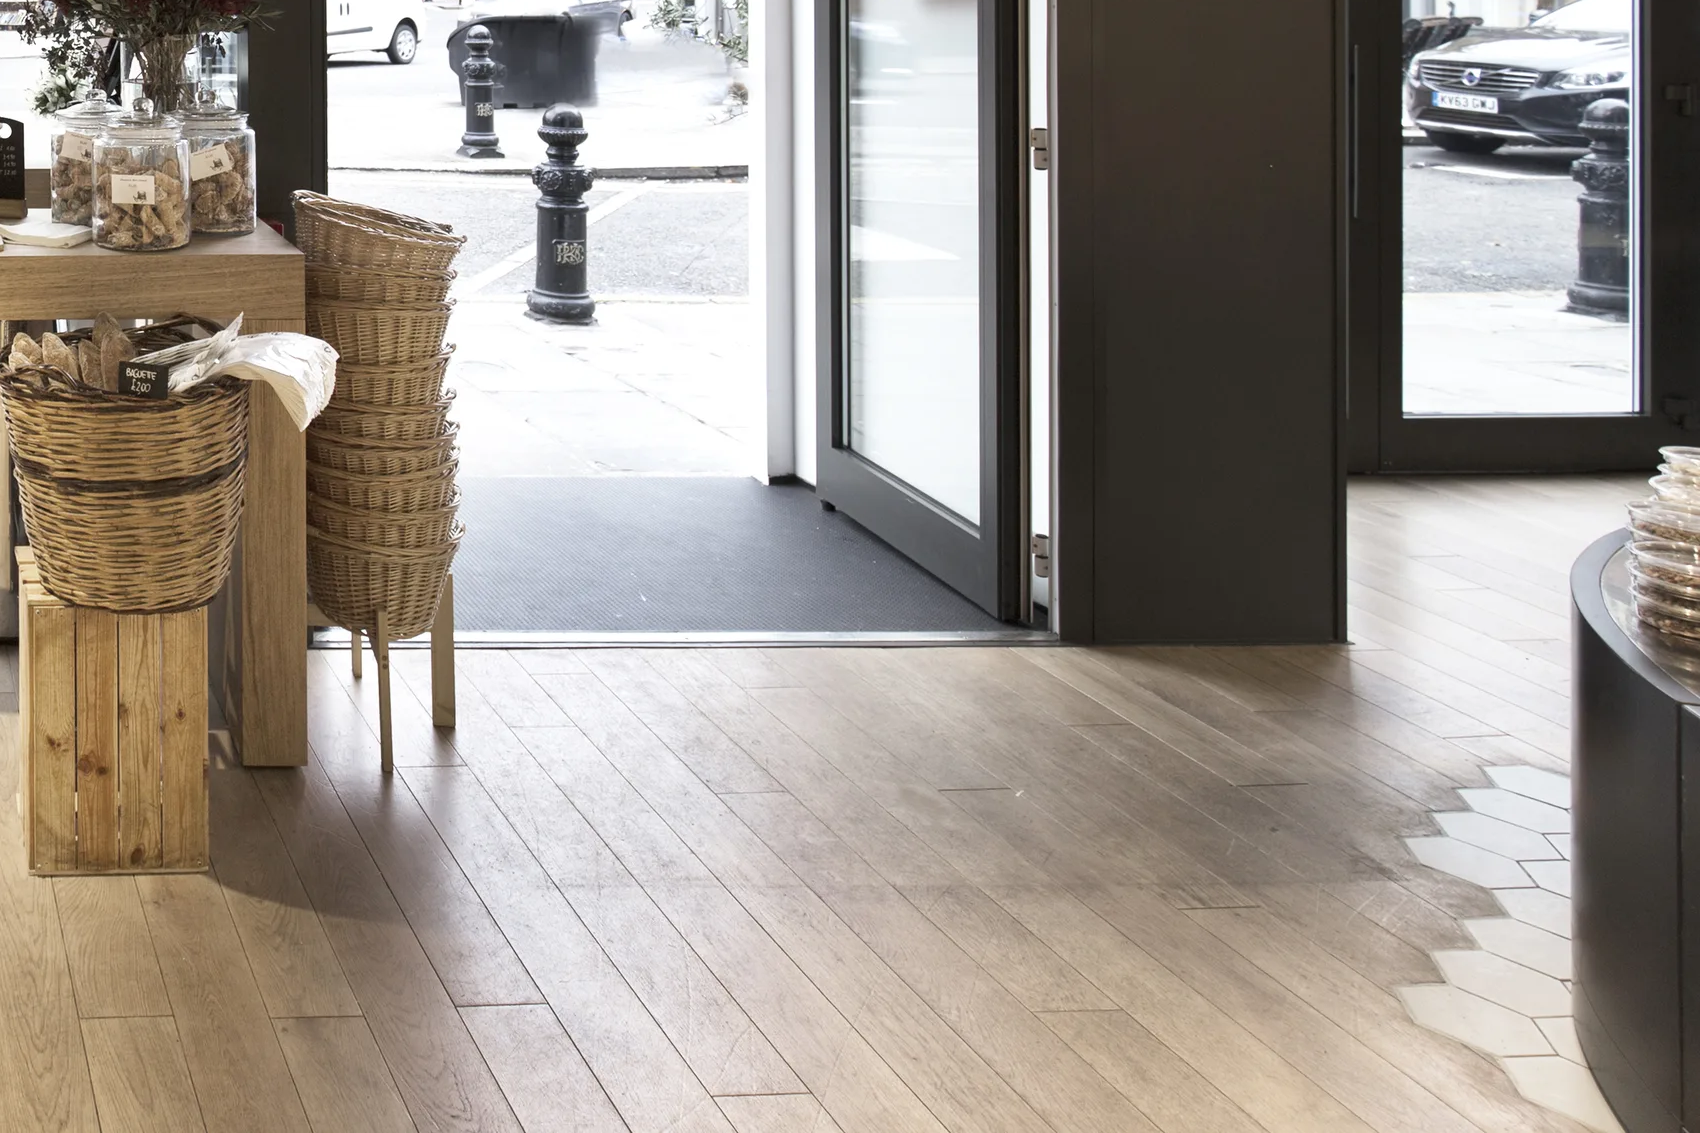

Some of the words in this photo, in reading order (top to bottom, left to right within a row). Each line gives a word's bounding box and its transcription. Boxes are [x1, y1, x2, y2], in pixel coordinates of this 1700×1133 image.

[1440, 93, 1469, 108] KV63
[1472, 97, 1496, 110] GWJ
[125, 367, 158, 382] BAGUETTE
